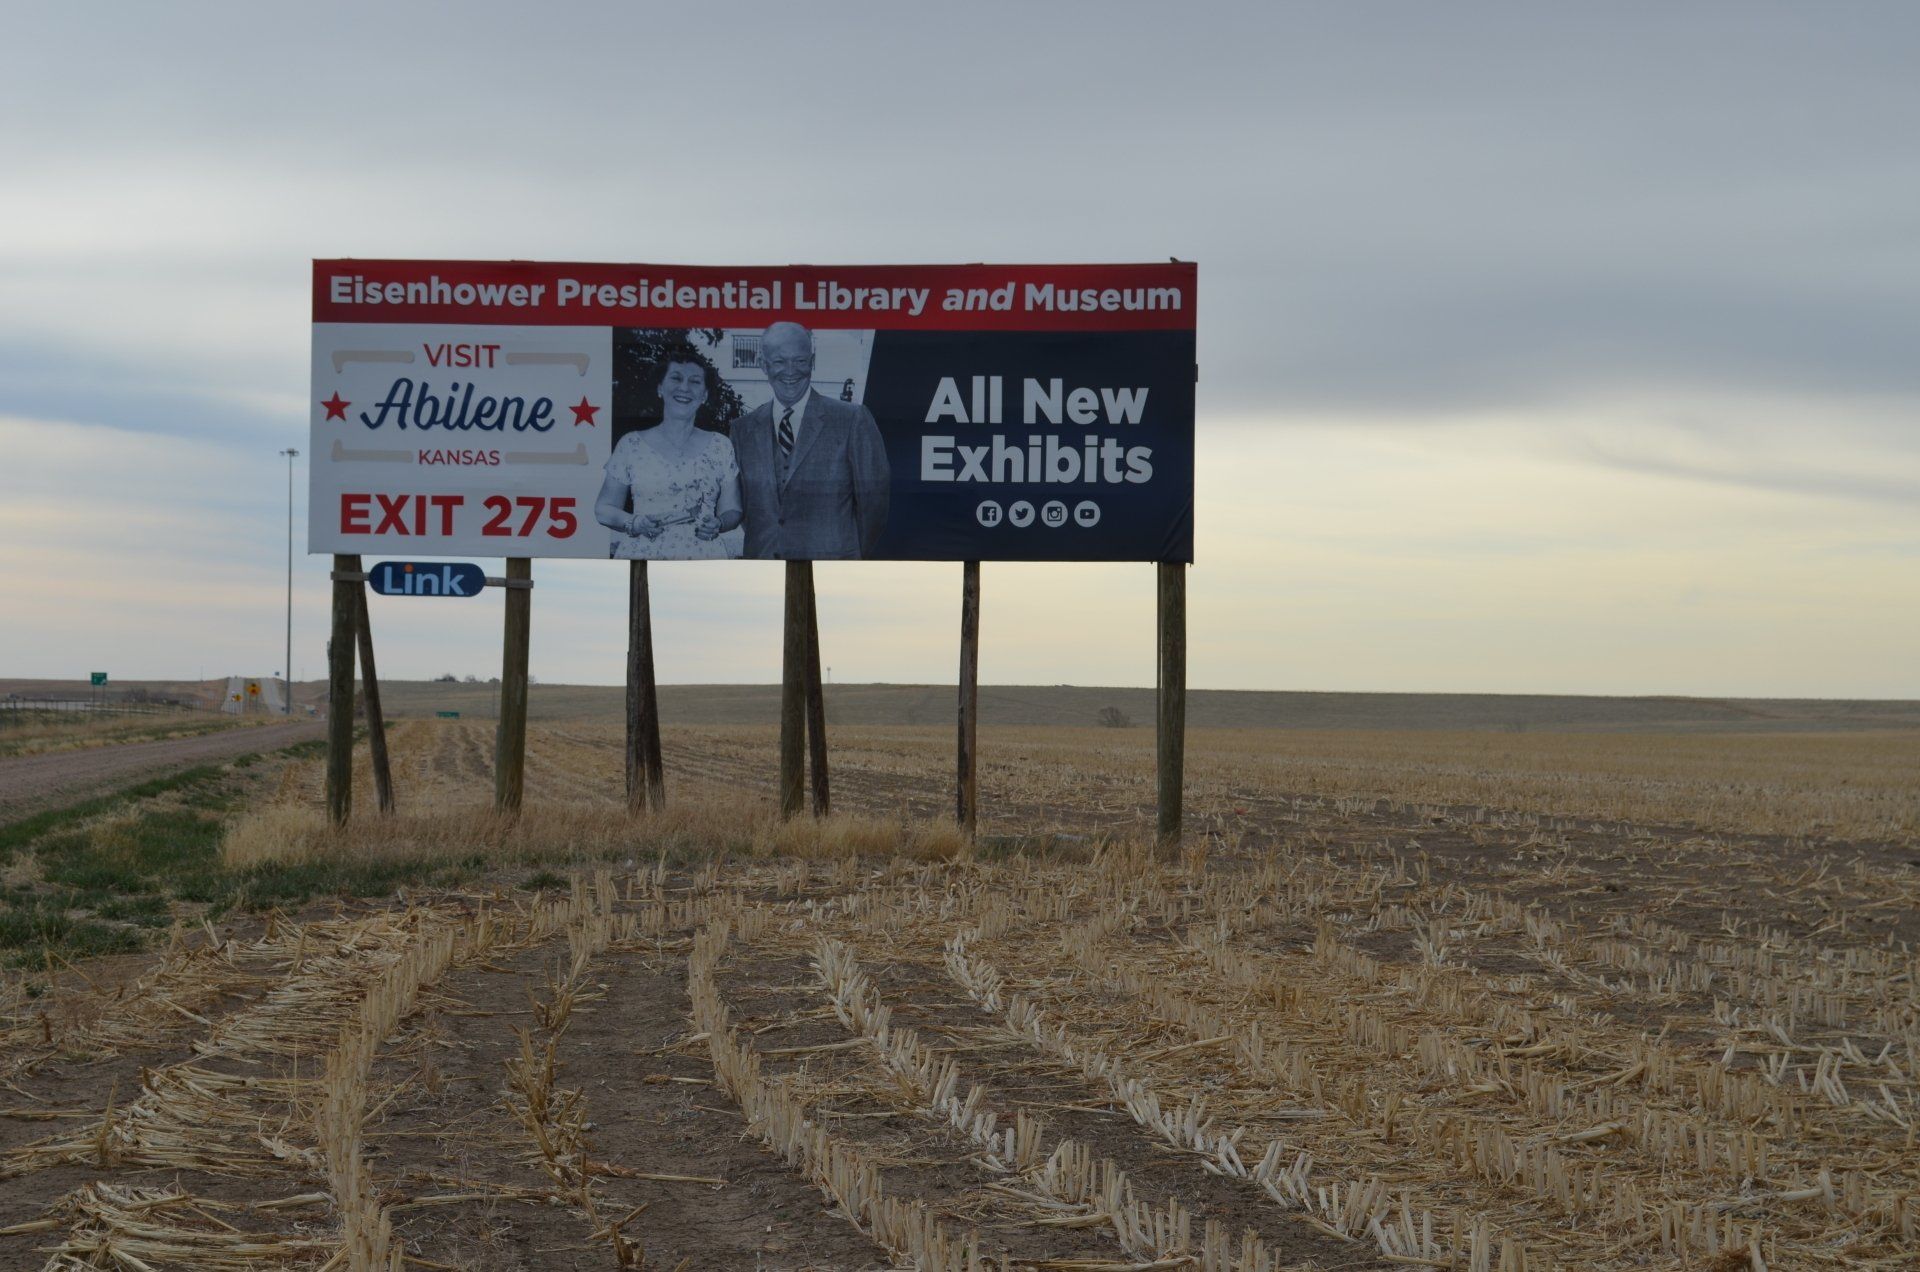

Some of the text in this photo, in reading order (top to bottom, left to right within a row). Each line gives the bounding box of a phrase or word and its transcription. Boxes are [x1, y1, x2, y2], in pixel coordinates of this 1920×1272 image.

[330, 275, 1182, 316] Eisenhower Presidential Library and Museum
[423, 344, 501, 368] VISIT
[359, 377, 556, 433] Abilene
[924, 375, 1149, 425] All New
[418, 449, 501, 467] KANSAS
[920, 434, 1154, 484] Exhibits
[340, 493, 578, 539] EXIT 275
[383, 563, 465, 596] Link
